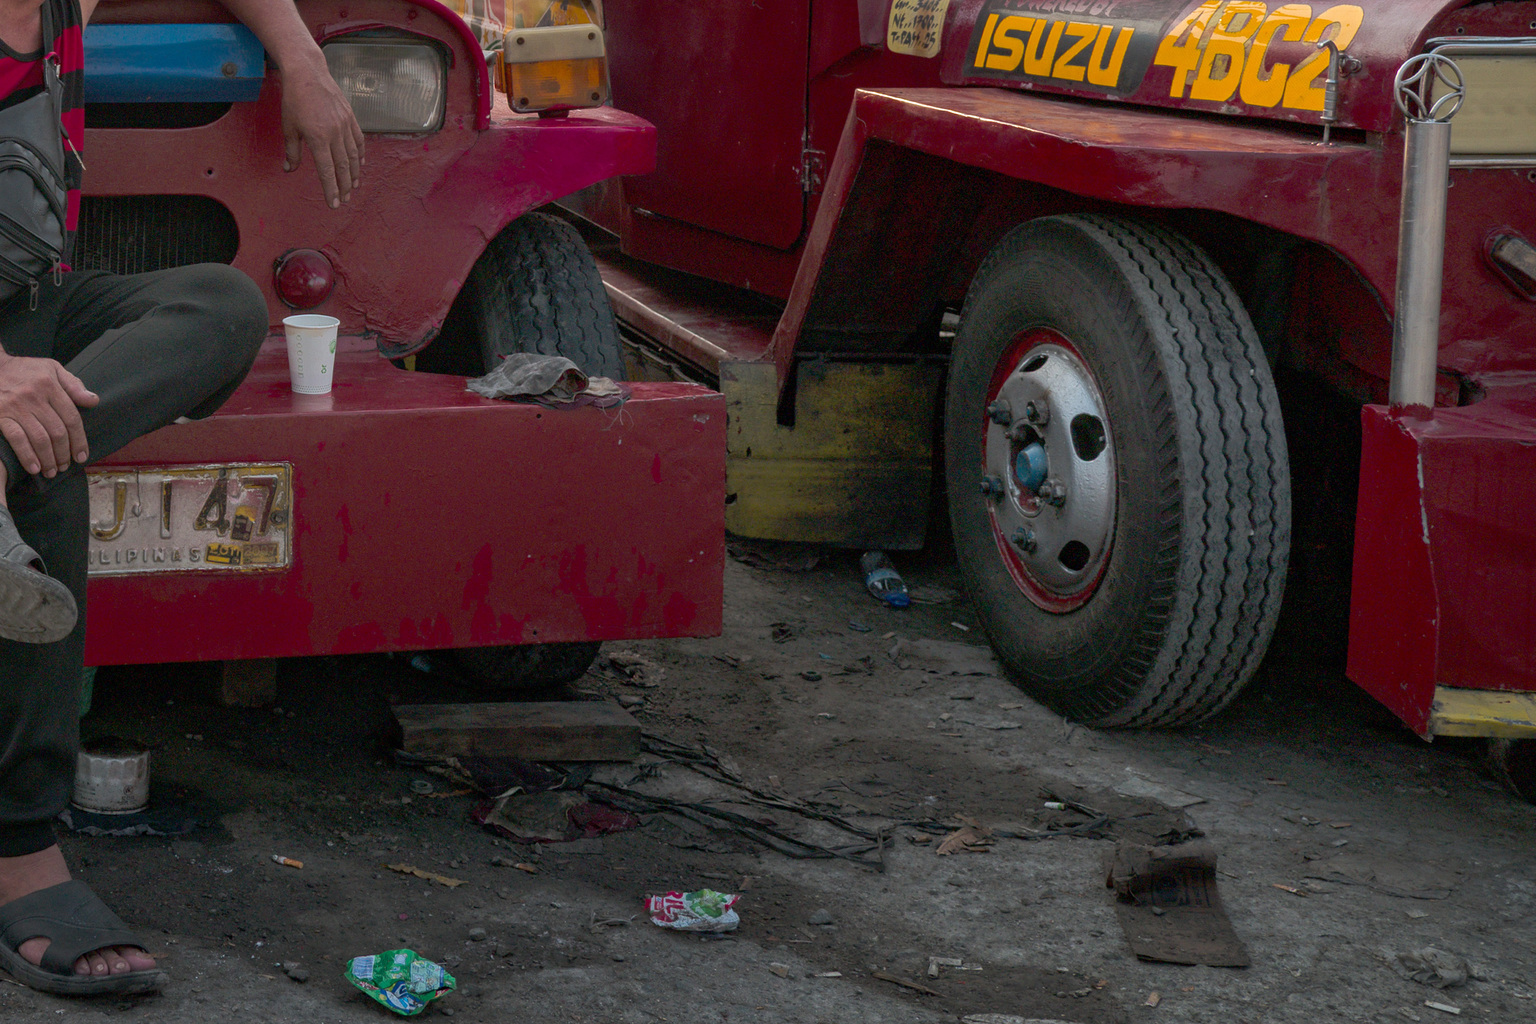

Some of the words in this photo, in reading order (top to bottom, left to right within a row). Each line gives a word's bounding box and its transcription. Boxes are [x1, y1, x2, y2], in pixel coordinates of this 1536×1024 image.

[974, 13, 1135, 88] ISUZU
[1153, 0, 1364, 112] 4BC2
[89, 547, 201, 565] ILIPINAS
